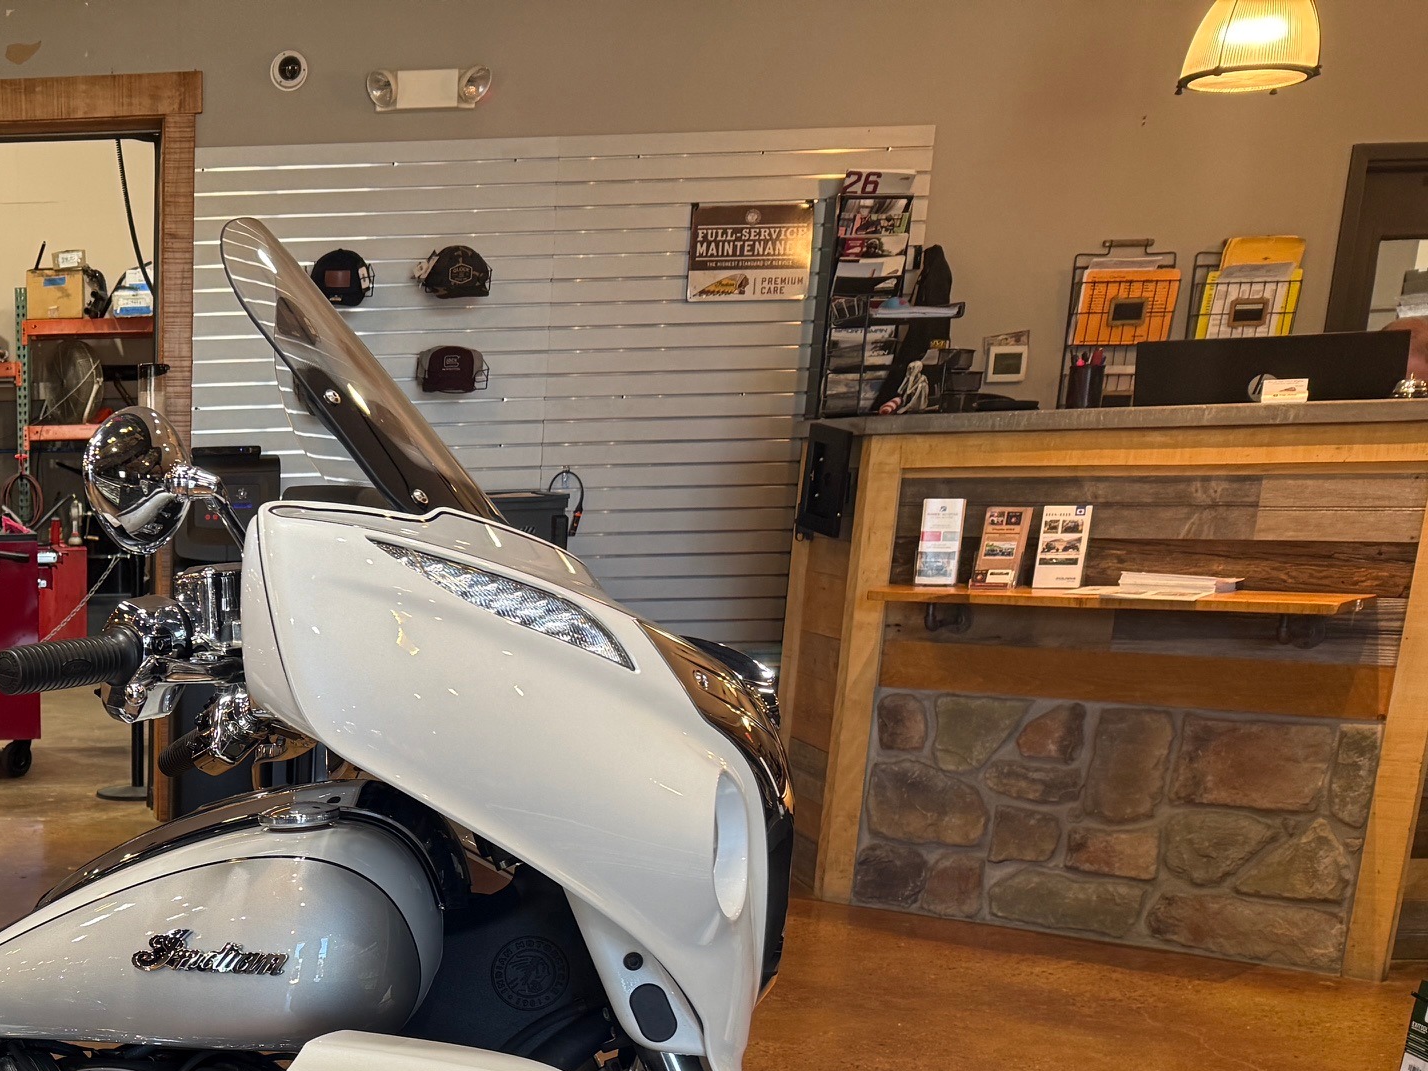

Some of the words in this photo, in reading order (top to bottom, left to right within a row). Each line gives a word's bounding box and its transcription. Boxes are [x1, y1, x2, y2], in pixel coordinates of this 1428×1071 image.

[842, 170, 882, 195] 26
[697, 227, 808, 241] FULL-SERVICE
[760, 277, 804, 286] PREMIUM
[760, 285, 785, 295] CARE
[132, 929, 289, 976] Indian
